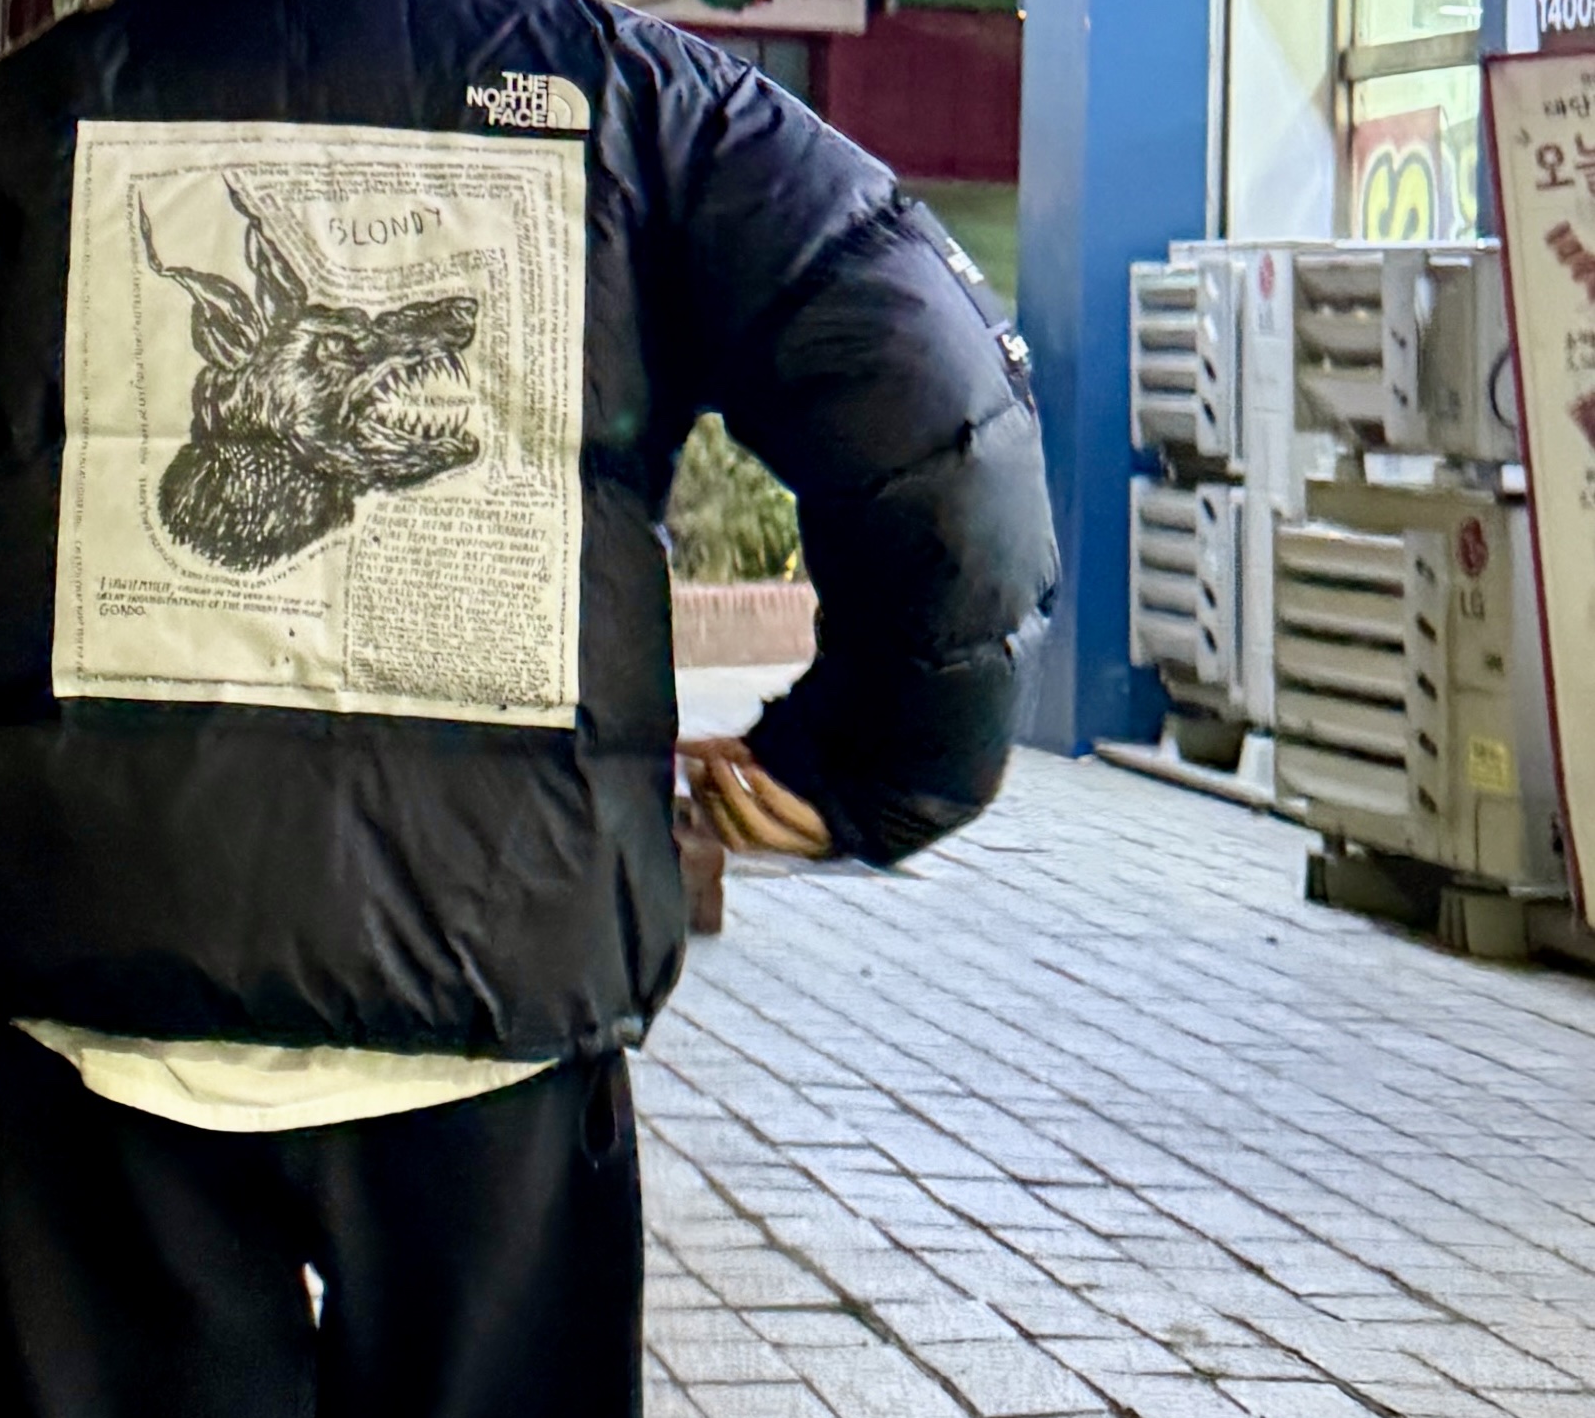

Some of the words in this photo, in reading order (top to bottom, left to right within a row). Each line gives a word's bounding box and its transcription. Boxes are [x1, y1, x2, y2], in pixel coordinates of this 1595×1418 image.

[501, 71, 548, 93] THE
[466, 86, 548, 112] NORTH
[488, 106, 547, 128] FACE
[329, 208, 442, 246] BLONDY
